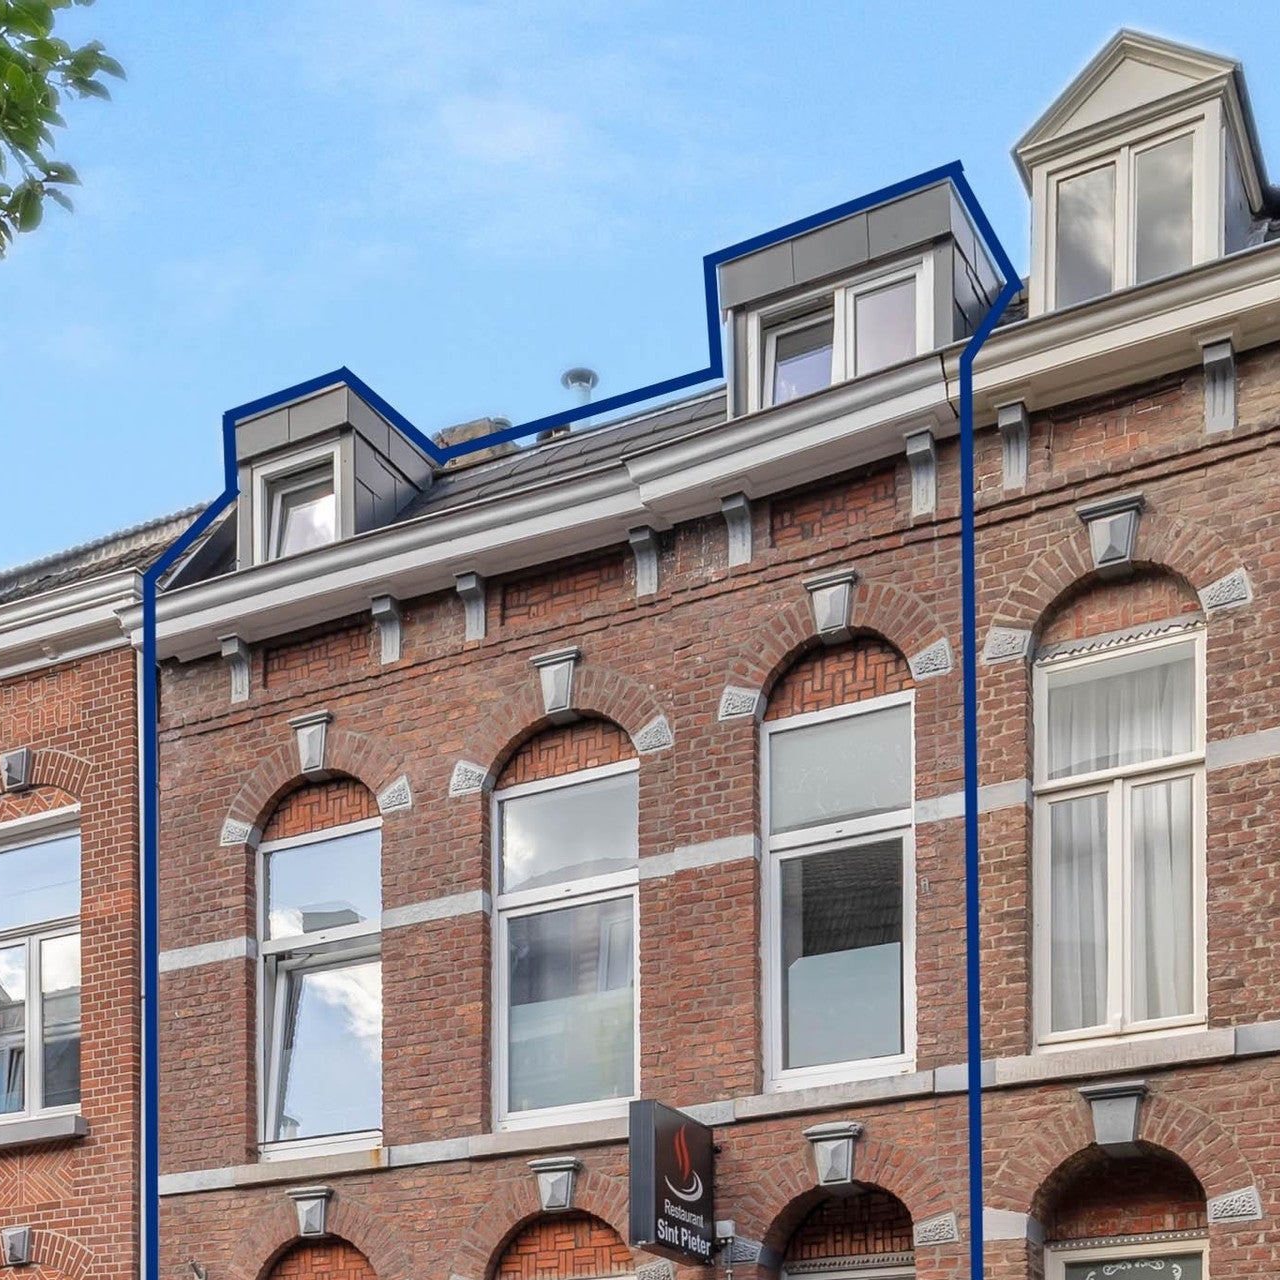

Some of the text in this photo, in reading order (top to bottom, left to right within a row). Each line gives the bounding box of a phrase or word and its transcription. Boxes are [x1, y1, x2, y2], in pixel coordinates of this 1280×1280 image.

[664, 1199, 704, 1228] Restaurant
[657, 1218, 711, 1256] Sint Pieter
